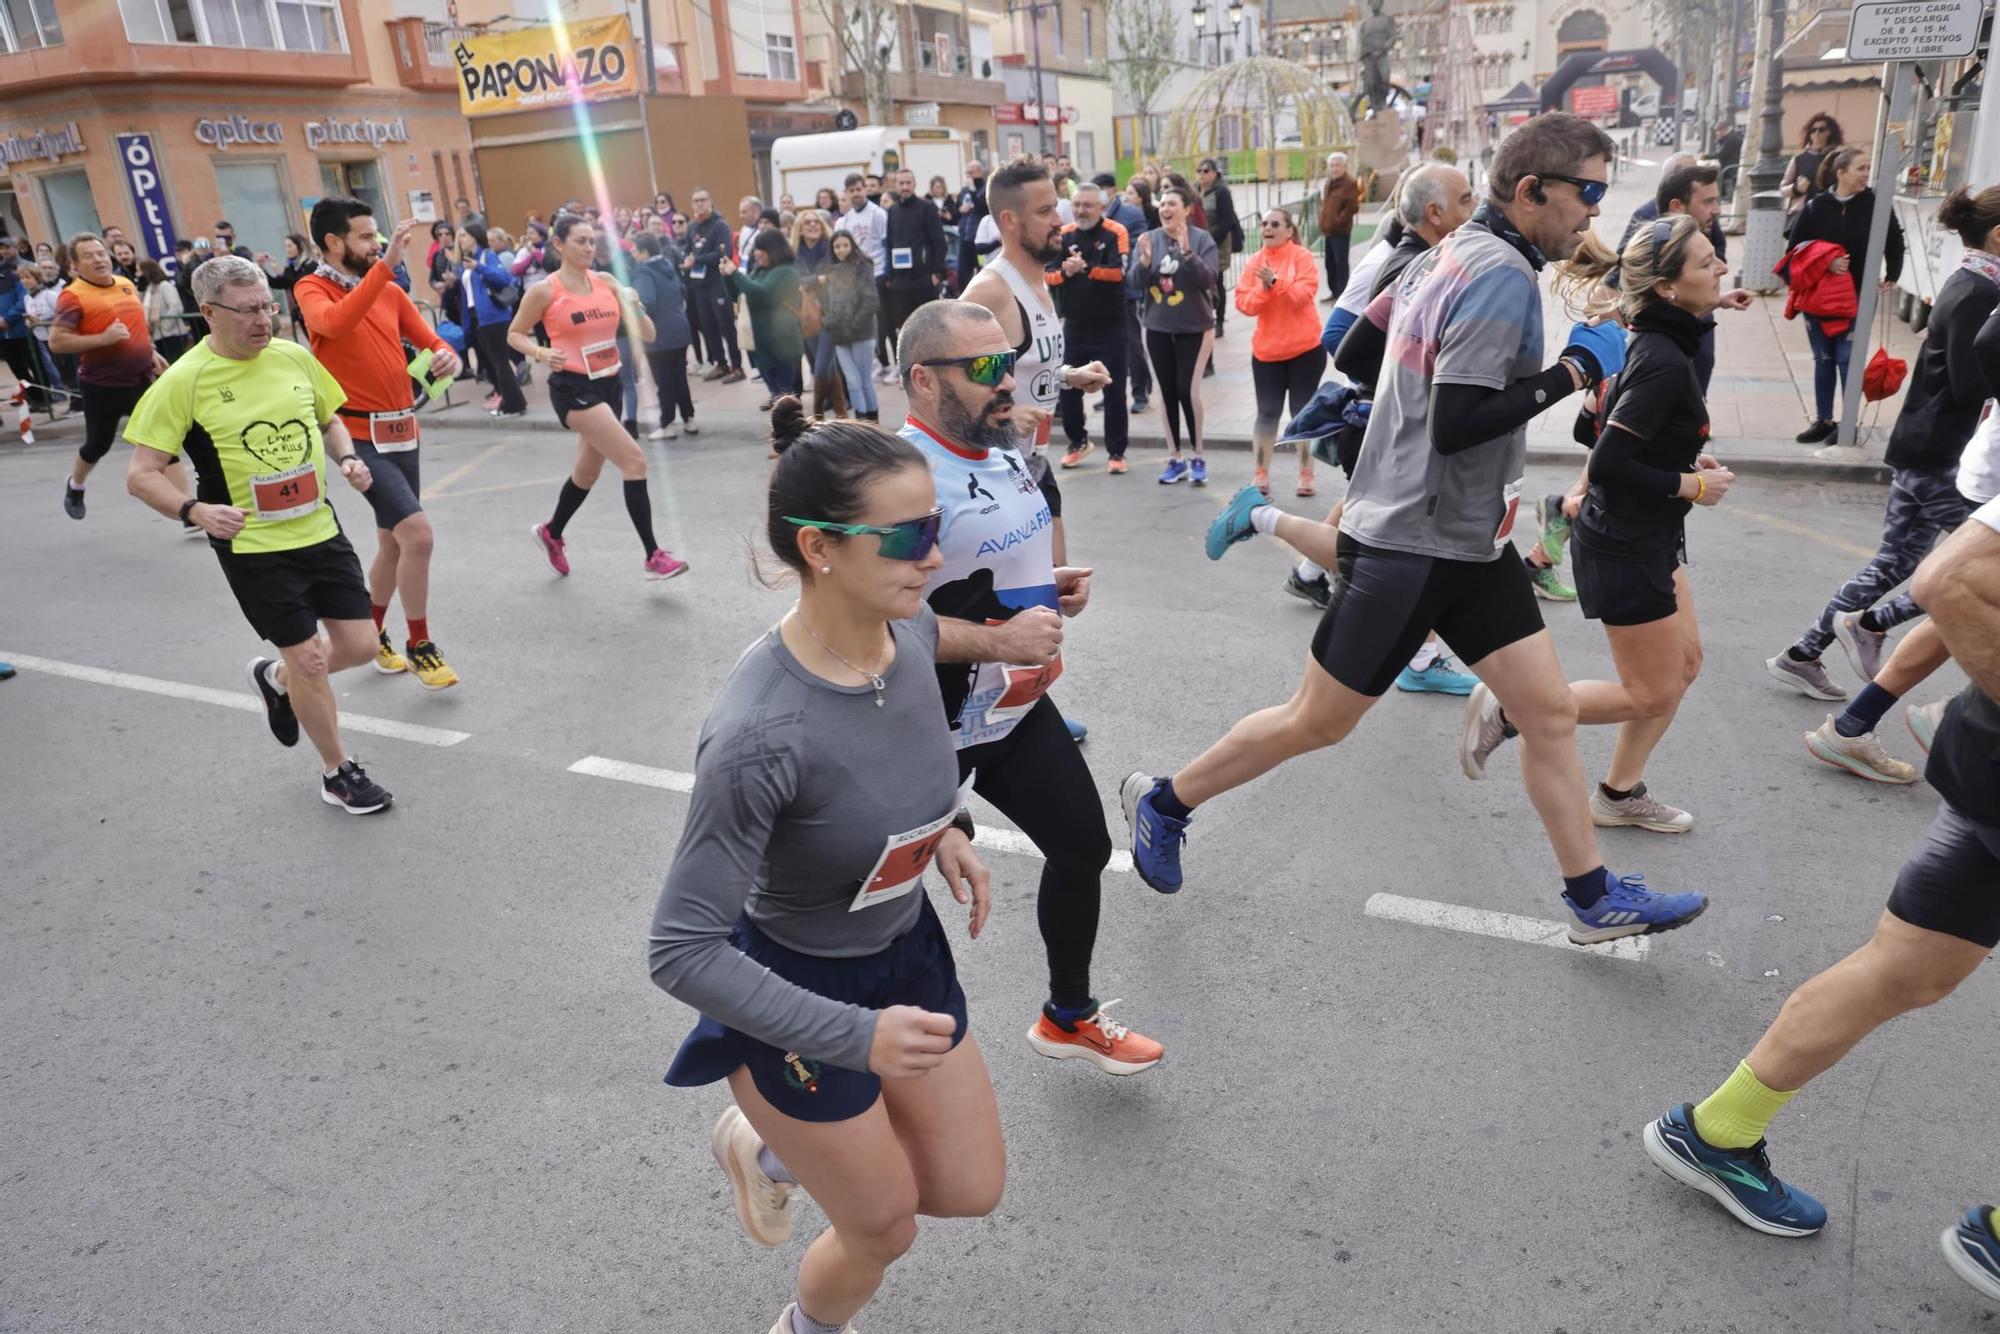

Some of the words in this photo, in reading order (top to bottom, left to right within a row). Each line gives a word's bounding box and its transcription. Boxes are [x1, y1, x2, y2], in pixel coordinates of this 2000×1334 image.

[1875, 5, 1920, 16] EXCEPTO
[1926, 3, 1961, 12] CARGA
[1894, 14, 1949, 24] DESCARGA
[1910, 26, 1918, 34] A
[1924, 25, 1933, 33] 15
[1864, 36, 1908, 46] EXCEPTO
[1914, 34, 1962, 44] FESTIVOS
[454, 42, 475, 67] EL
[1878, 46, 1910, 55] RESTO
[1916, 45, 1943, 54] LIBRE
[462, 44, 625, 101] PAPONAZO
[127, 137, 177, 278] óptic
[279, 481, 299, 497] 41
